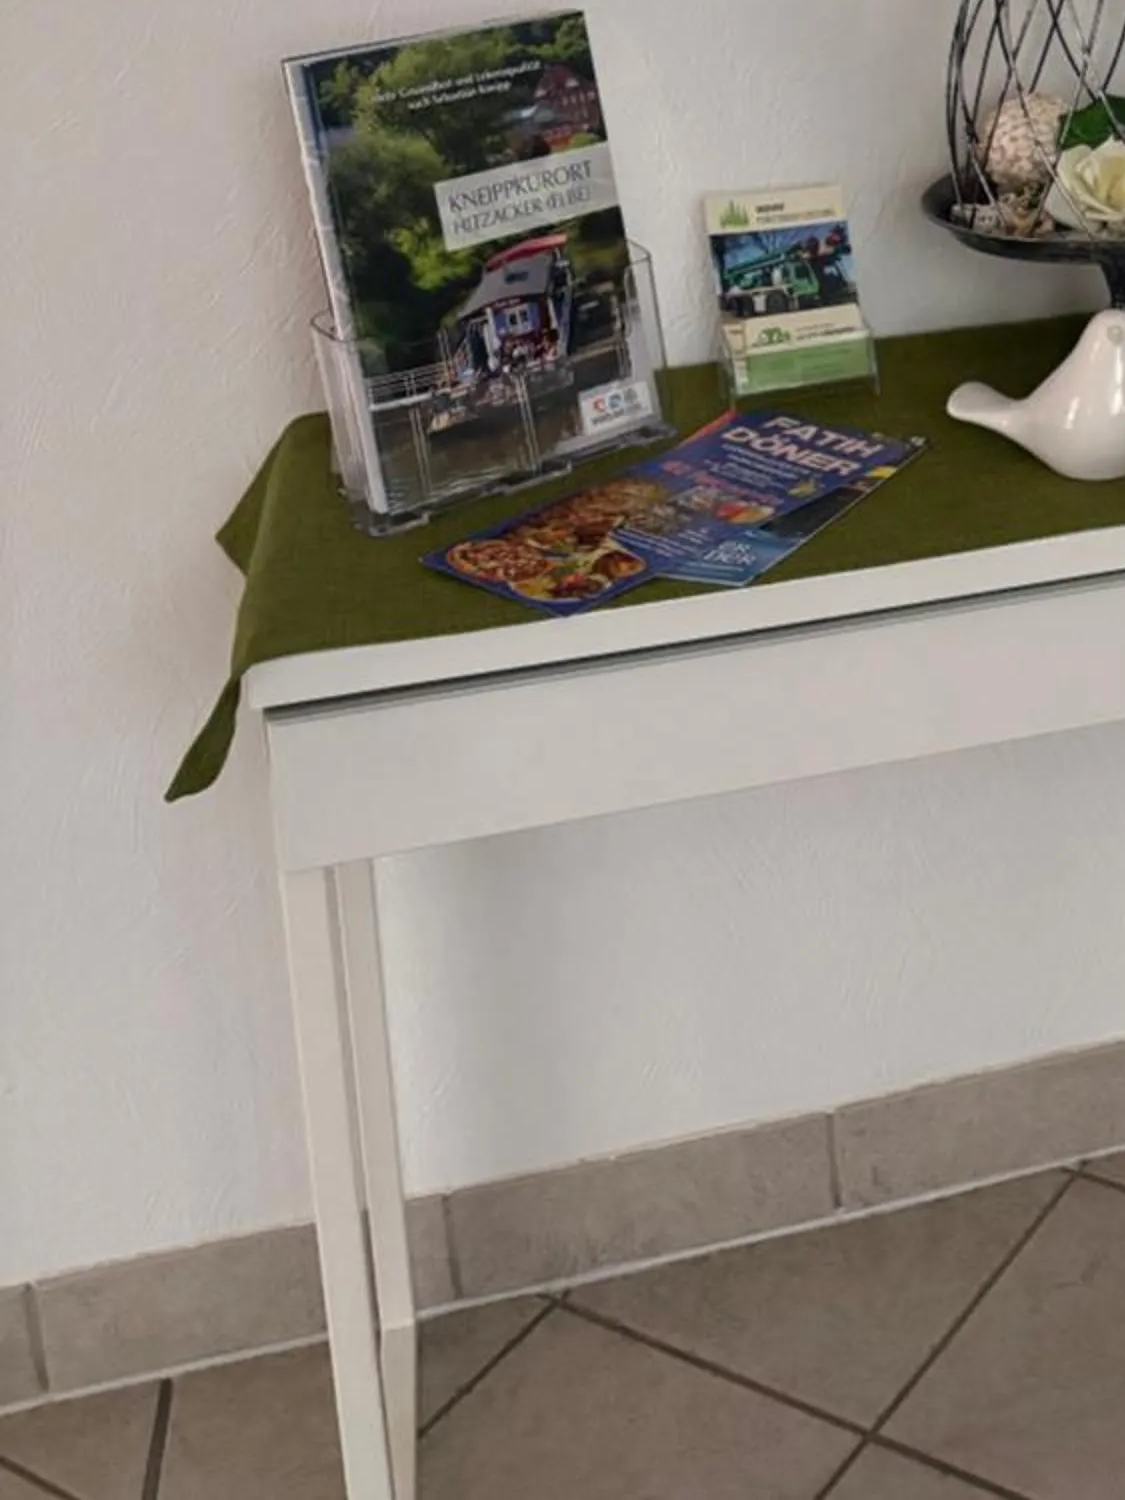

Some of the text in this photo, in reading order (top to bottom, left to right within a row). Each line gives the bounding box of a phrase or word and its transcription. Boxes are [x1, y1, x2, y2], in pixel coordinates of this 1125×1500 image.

[449, 160, 592, 213] KNEIPPKURORT
[453, 198, 543, 234] HITZACKER
[721, 426, 862, 476] DÖNER
[762, 416, 884, 458] FATIH
